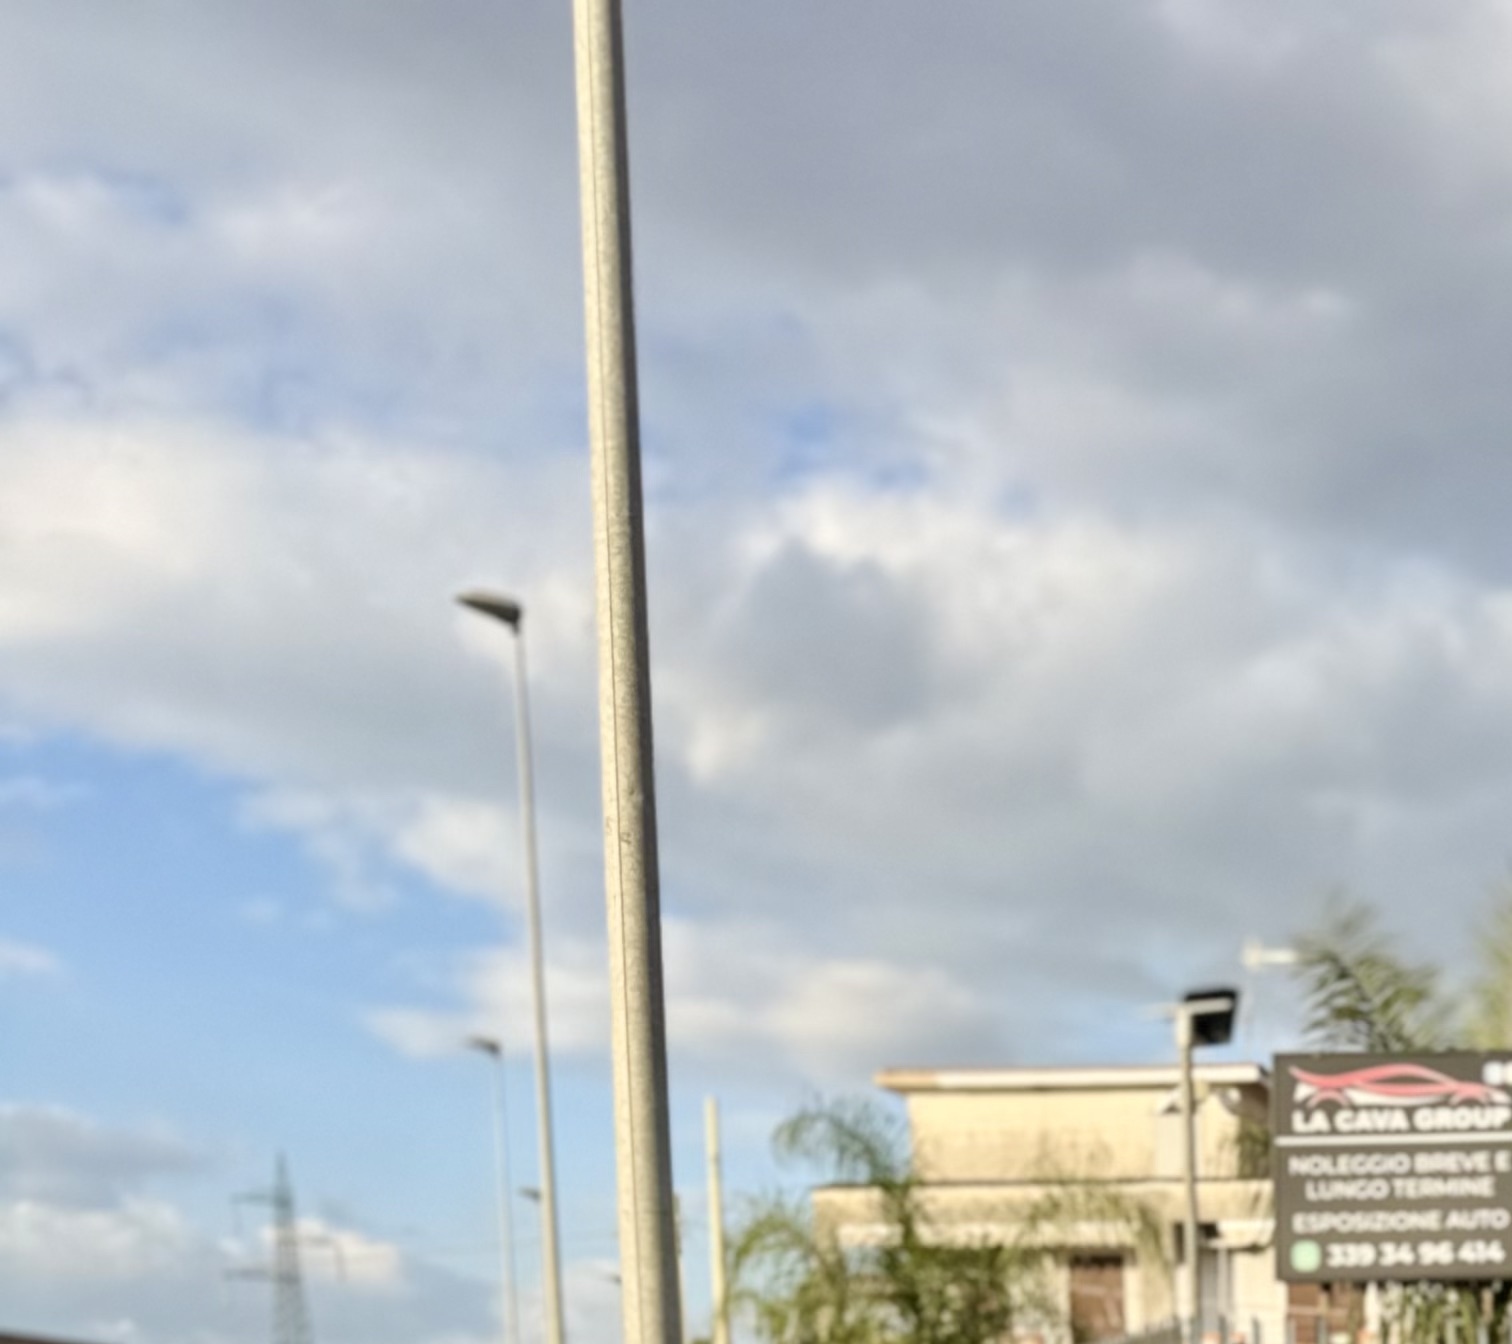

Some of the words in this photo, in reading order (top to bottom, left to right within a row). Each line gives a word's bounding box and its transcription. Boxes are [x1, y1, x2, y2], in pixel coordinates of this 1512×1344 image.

[1292, 1109, 1330, 1132] LA
[1334, 1107, 1409, 1131] CAVA
[1413, 1106, 1512, 1130] GROUP
[1289, 1153, 1411, 1175] NOLEGGIO
[1414, 1151, 1488, 1173] BREVE
[1495, 1151, 1511, 1171] E
[1305, 1179, 1390, 1201] LUNGO
[1393, 1176, 1494, 1198] TERMINE
[1446, 1209, 1511, 1230] AUTO
